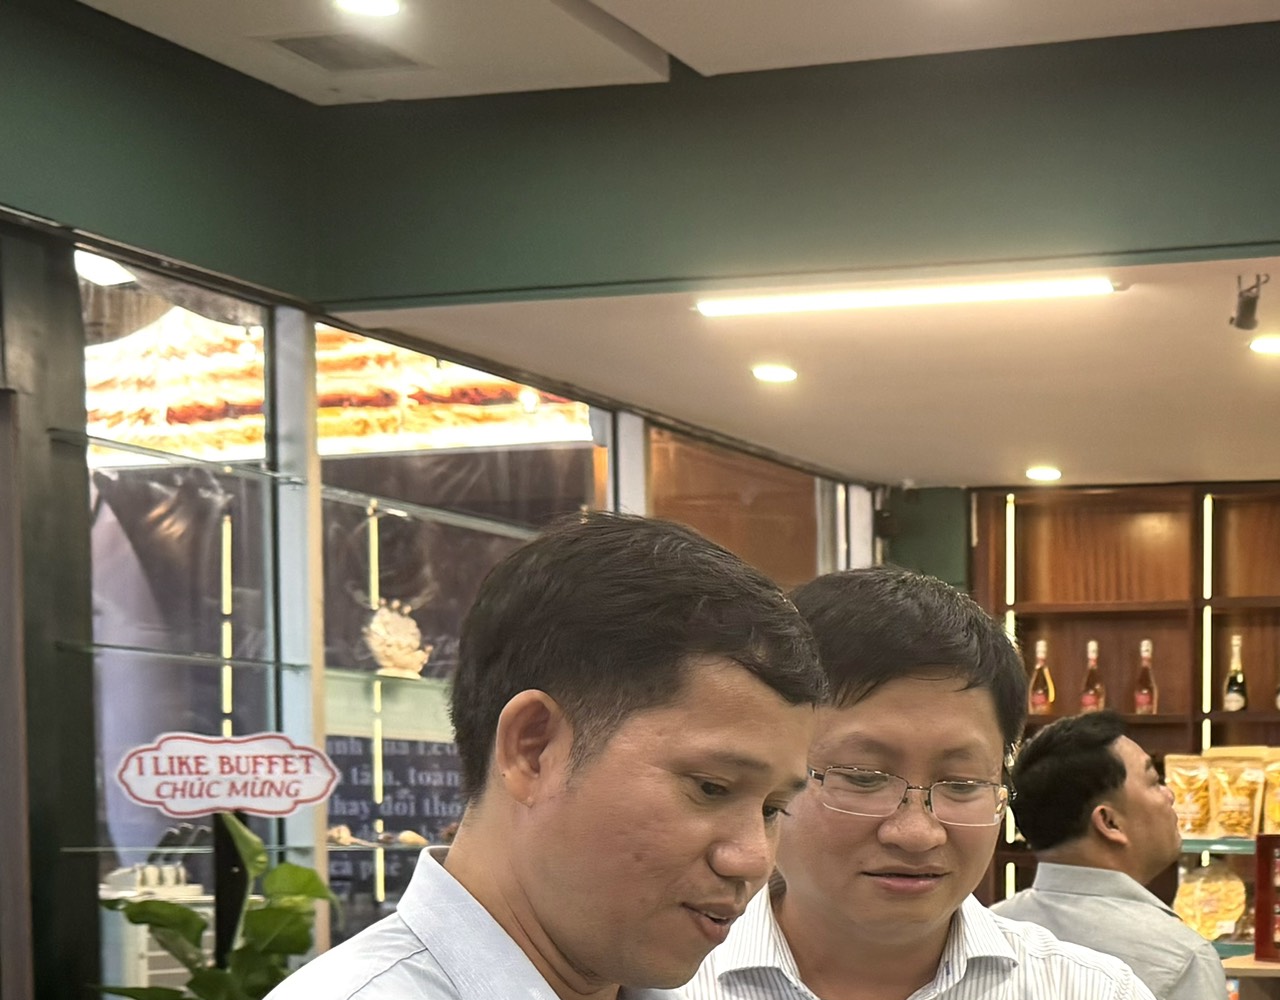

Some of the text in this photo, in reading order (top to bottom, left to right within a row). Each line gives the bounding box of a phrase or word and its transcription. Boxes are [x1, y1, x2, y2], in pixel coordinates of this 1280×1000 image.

[136, 754, 315, 777] I LIKE BUFFET
[154, 777, 221, 799] CHÚC
